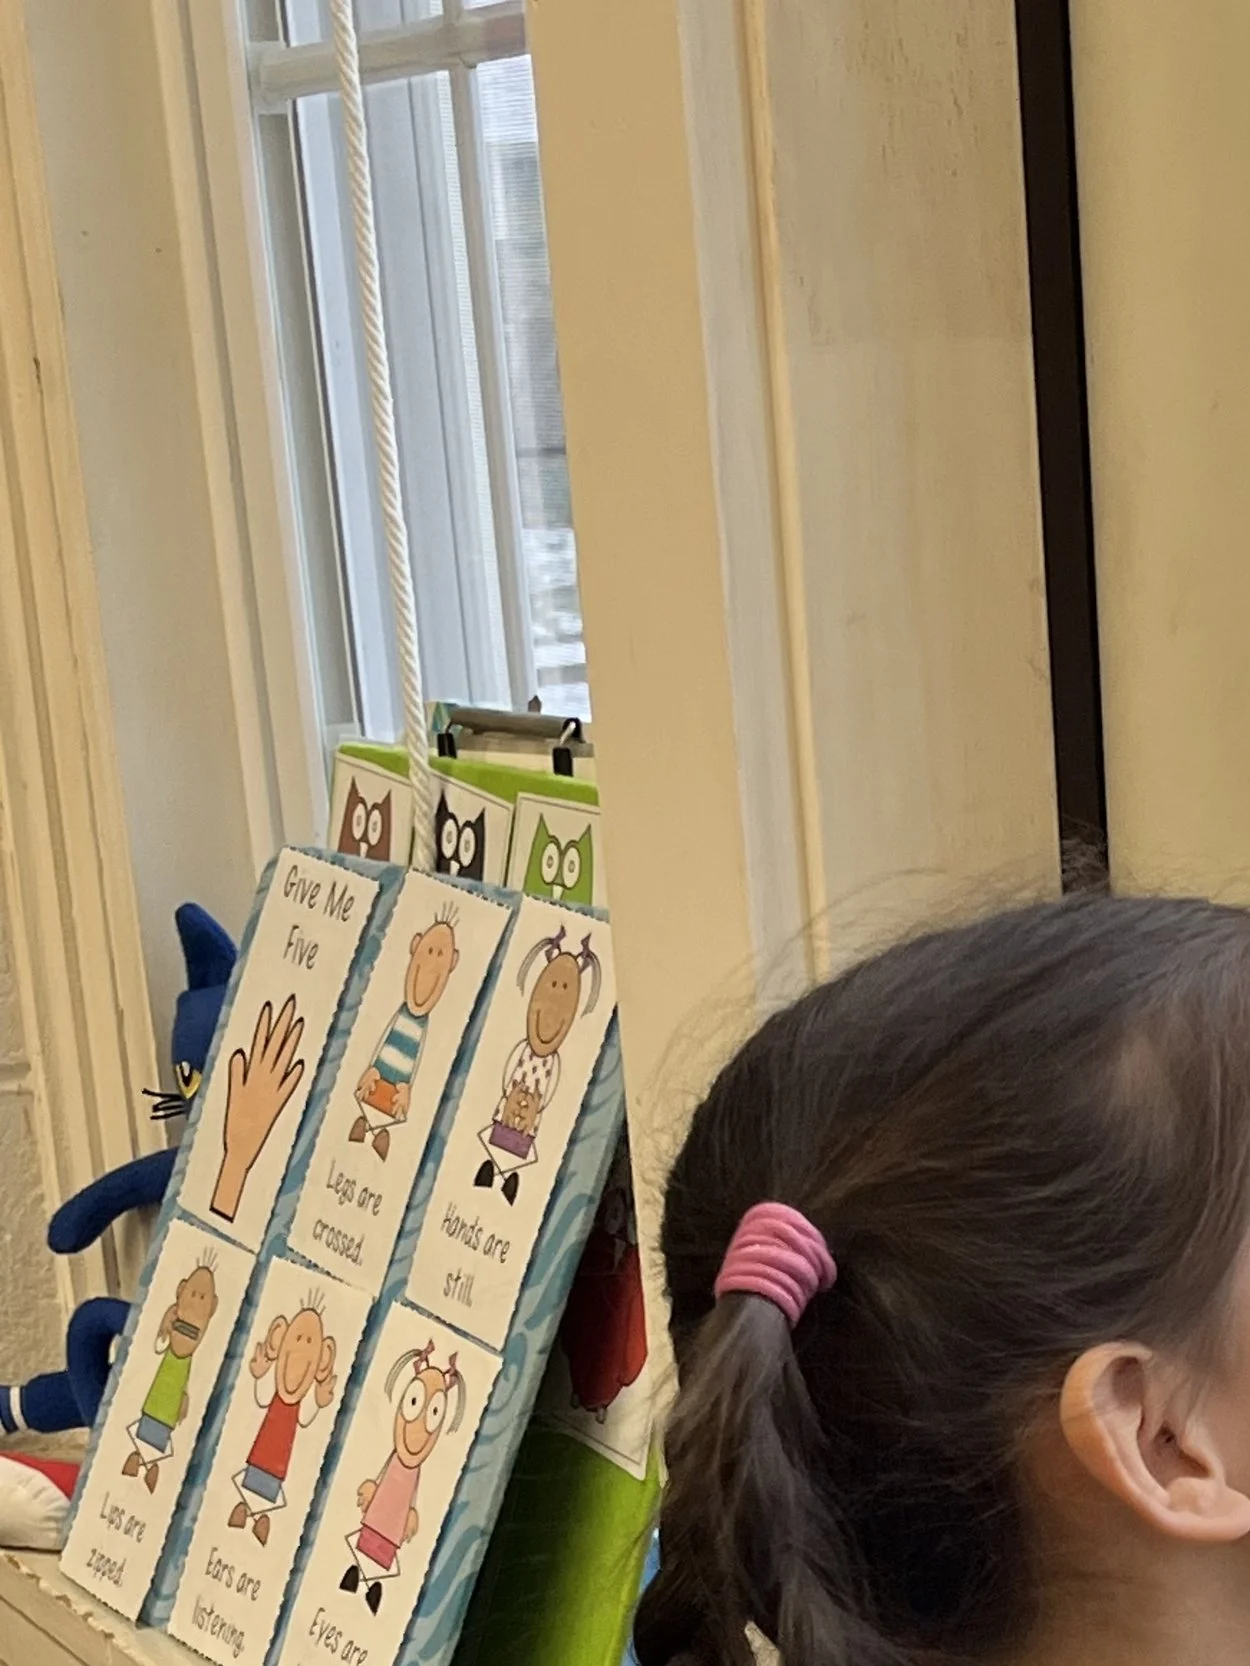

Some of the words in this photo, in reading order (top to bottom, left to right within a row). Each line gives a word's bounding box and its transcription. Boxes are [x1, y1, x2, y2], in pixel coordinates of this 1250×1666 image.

[284, 865, 321, 909] Give
[323, 881, 355, 921] Me
[283, 924, 319, 969] Five
[326, 1157, 357, 1206] Legs
[357, 1187, 382, 1216] are
[312, 1218, 365, 1266] crossed.
[441, 1202, 483, 1251] Hands
[483, 1233, 510, 1263] are
[100, 1491, 125, 1531] Lips
[123, 1515, 146, 1543] are
[205, 1546, 235, 1588] Ears
[236, 1572, 261, 1601] are
[192, 1594, 245, 1658] listening.
[309, 1607, 343, 1654] Eyes
